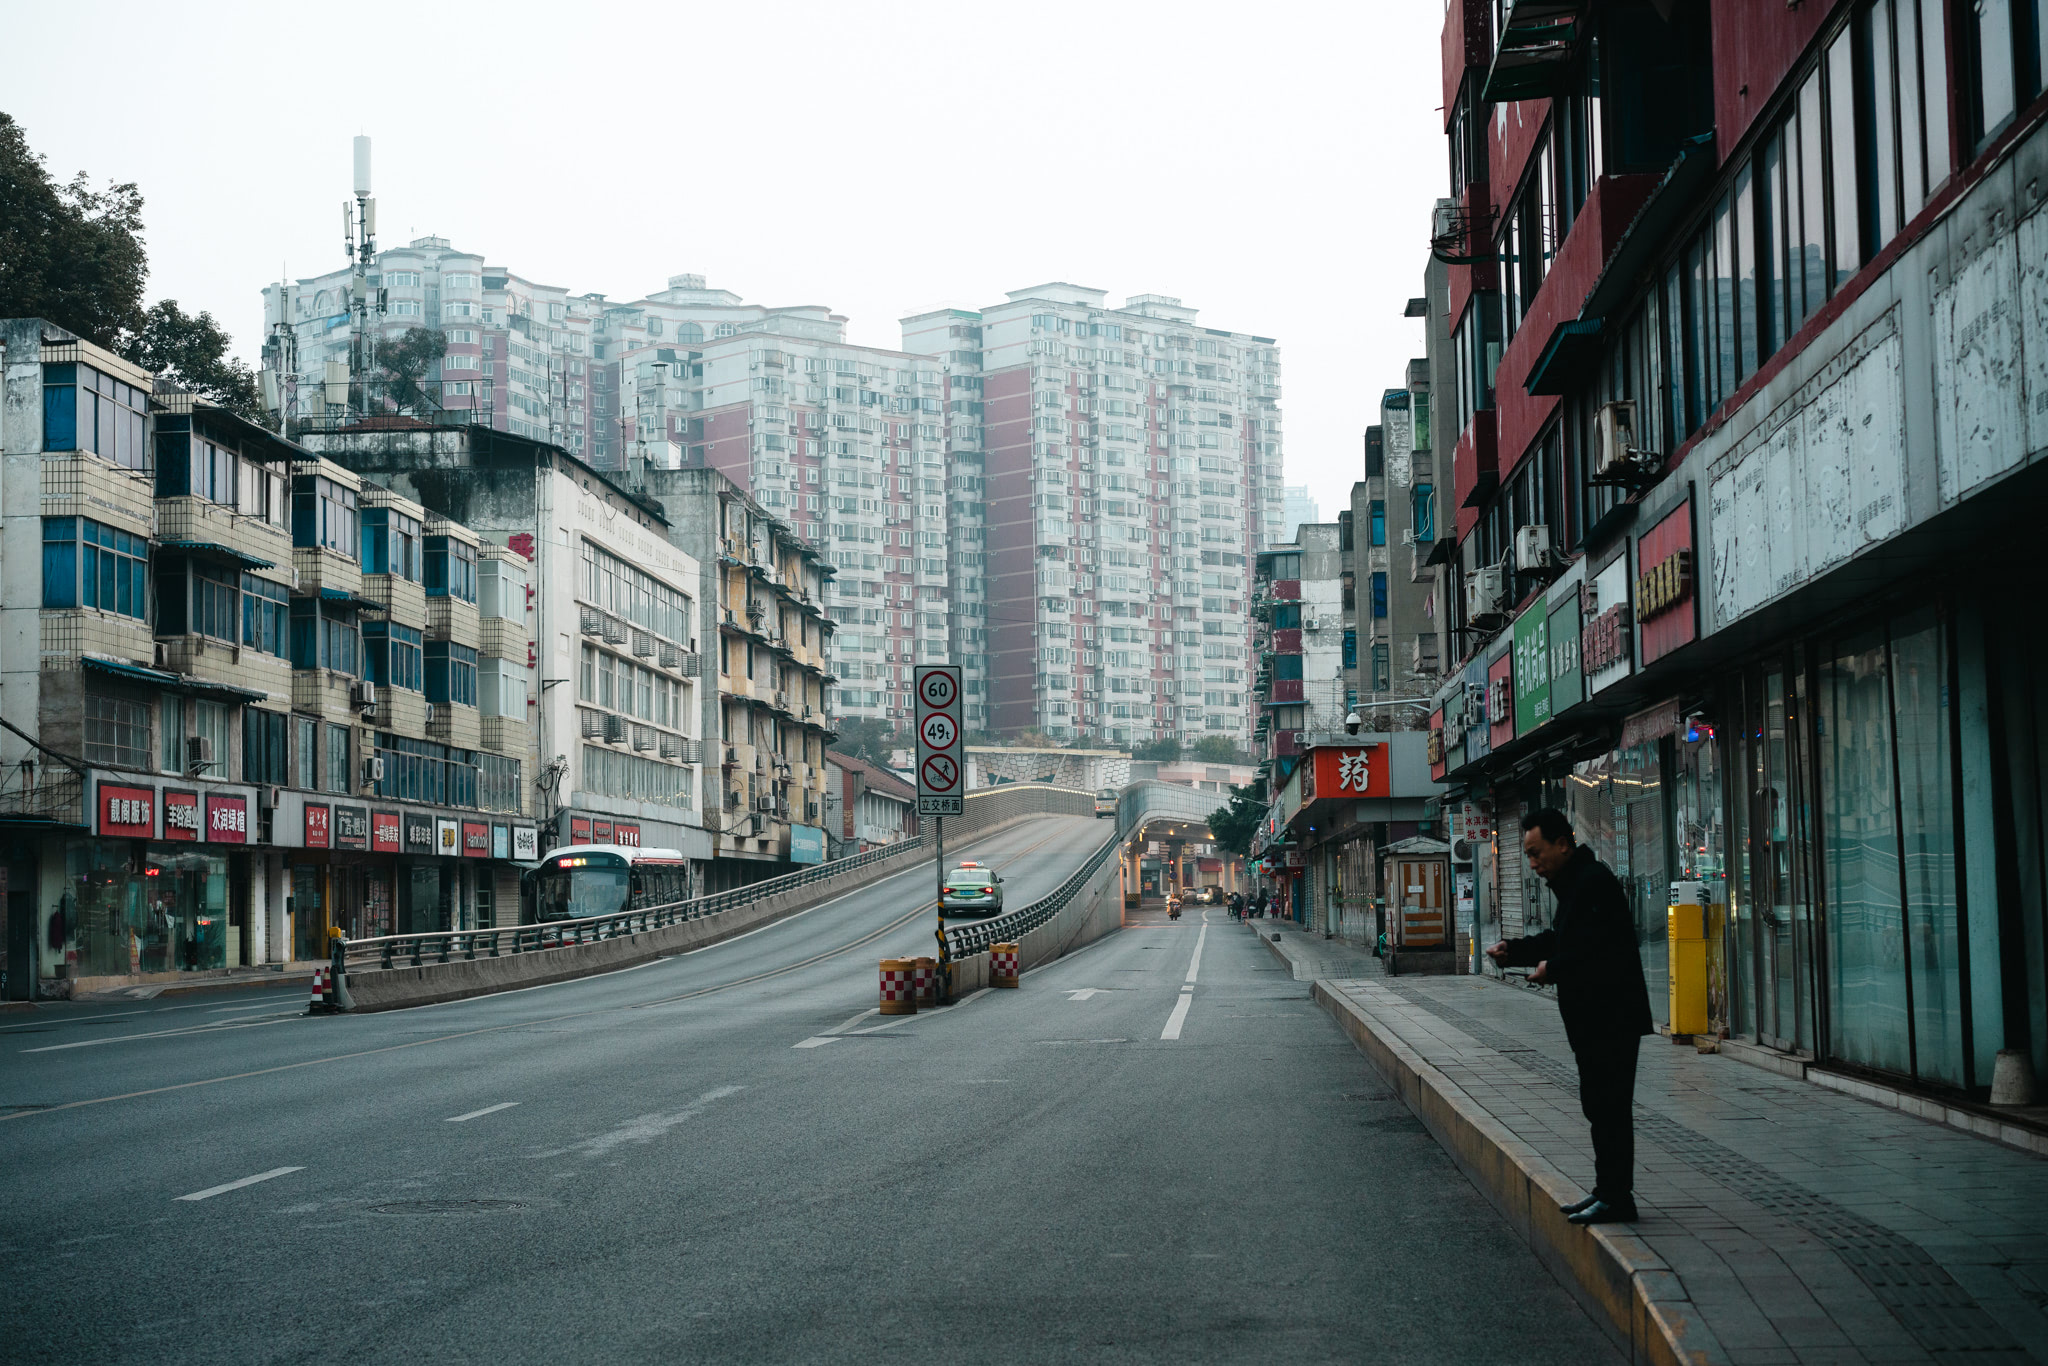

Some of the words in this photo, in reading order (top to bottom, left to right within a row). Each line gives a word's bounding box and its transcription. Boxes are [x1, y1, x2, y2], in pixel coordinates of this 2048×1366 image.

[928, 682, 947, 697] 60
[927, 723, 950, 740] 49t
[1338, 750, 1369, 792] 药
[921, 799, 960, 812] 立交桥面
[212, 807, 246, 832] 水润绿植
[1465, 816, 1489, 826] 冰淇淋
[467, 831, 488, 848] Hankook
[559, 858, 571, 867] 109
